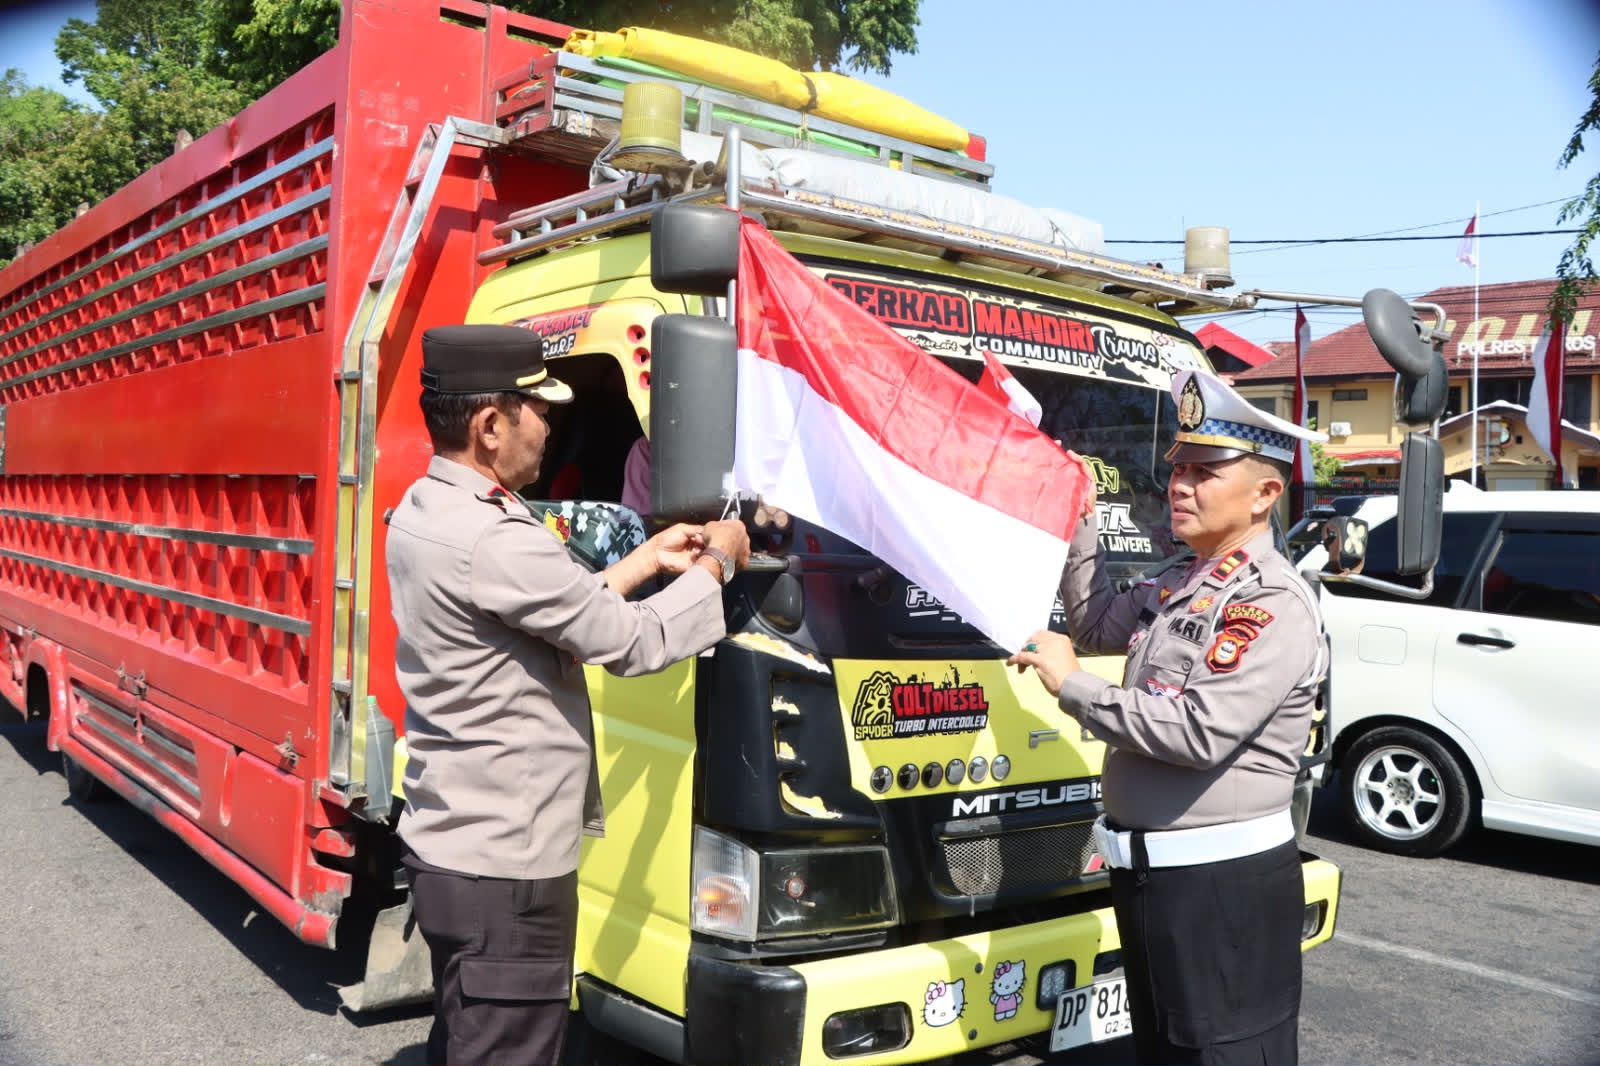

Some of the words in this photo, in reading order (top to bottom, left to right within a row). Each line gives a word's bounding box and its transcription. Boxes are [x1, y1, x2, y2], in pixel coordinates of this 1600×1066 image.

[974, 302, 1095, 352] MANDIRI
[1090, 325, 1158, 363] Trans
[974, 336, 1101, 369] COMMUNITY
[1096, 501, 1141, 534] TA
[892, 683, 935, 716] COLT
[933, 687, 987, 713] DIESEL
[855, 723, 894, 740] SPYDER
[894, 719, 926, 733] TURBO
[927, 714, 987, 731] INTERCOOLER
[1058, 993, 1087, 1031] DP
